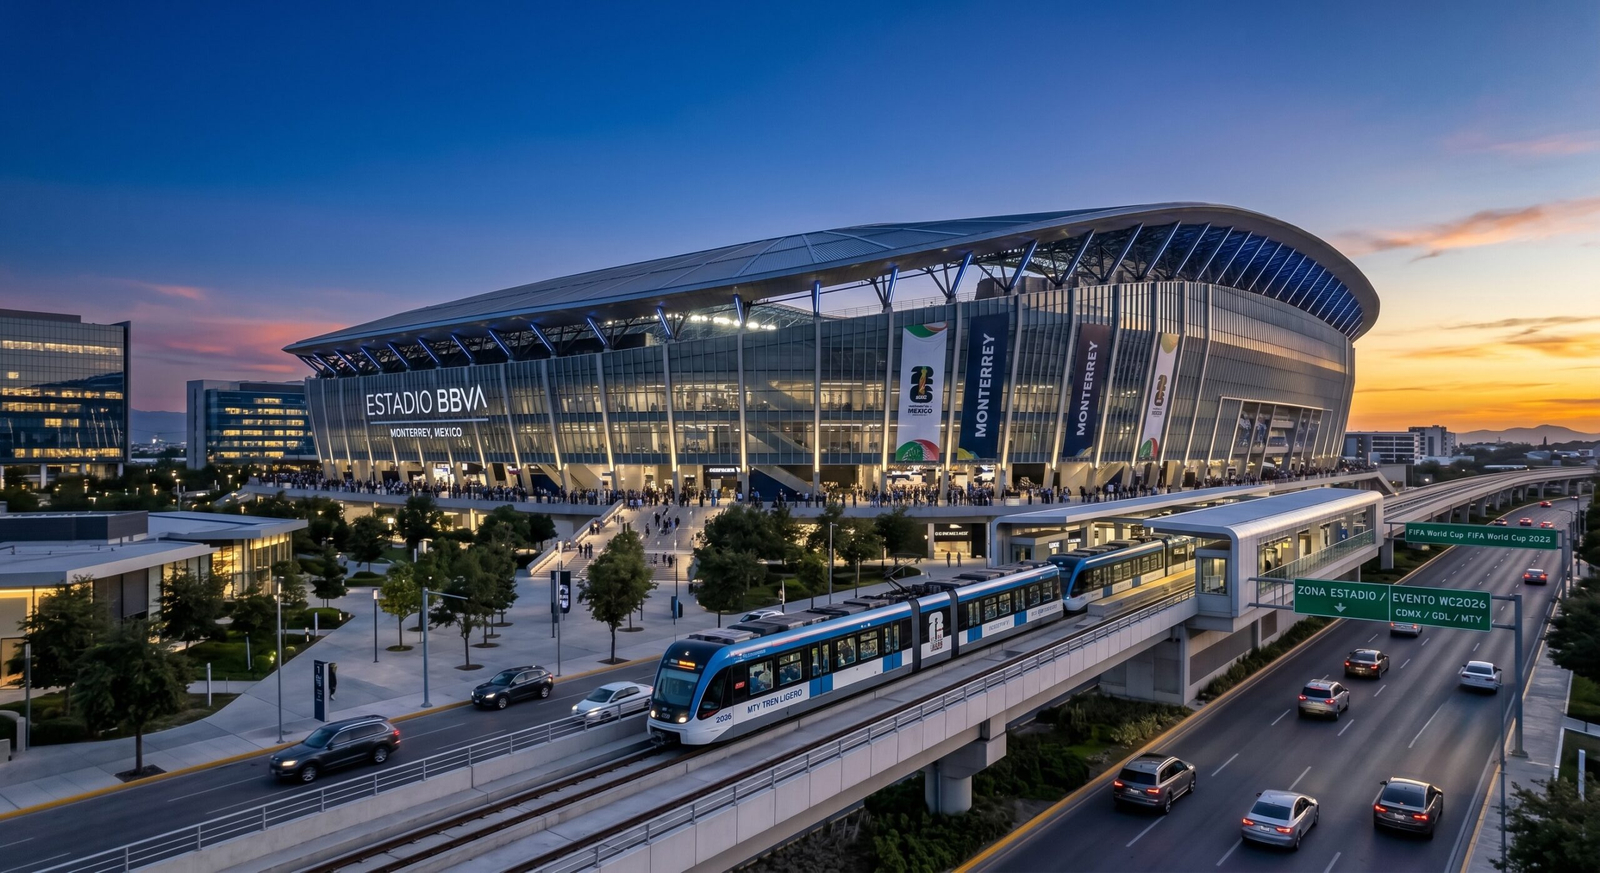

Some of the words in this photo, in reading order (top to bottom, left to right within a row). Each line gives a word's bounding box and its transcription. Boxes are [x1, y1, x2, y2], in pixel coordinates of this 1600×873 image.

[974, 333, 995, 438] MONTERREY
[1076, 340, 1098, 436] MONTERREY
[366, 390, 433, 416] ESTADIO
[437, 384, 488, 412] BBVA
[390, 428, 433, 439] MONTERREY,
[1427, 530, 1447, 538] World
[1450, 530, 1464, 539] Cup
[1468, 532, 1484, 540] FIFA
[1488, 532, 1508, 540] World
[1512, 534, 1526, 542] Cup
[1298, 586, 1326, 596] ZONA
[1330, 588, 1376, 600] ESTADIO
[1392, 592, 1436, 605] EVENTO
[1439, 596, 1486, 609] WC2026
[1396, 608, 1422, 618] CDMX
[1432, 612, 1450, 621] GDL
[1461, 614, 1482, 624] MTY
[747, 702, 761, 714] MTY
[762, 696, 779, 708] TREN
[780, 688, 802, 702] LIGERO
